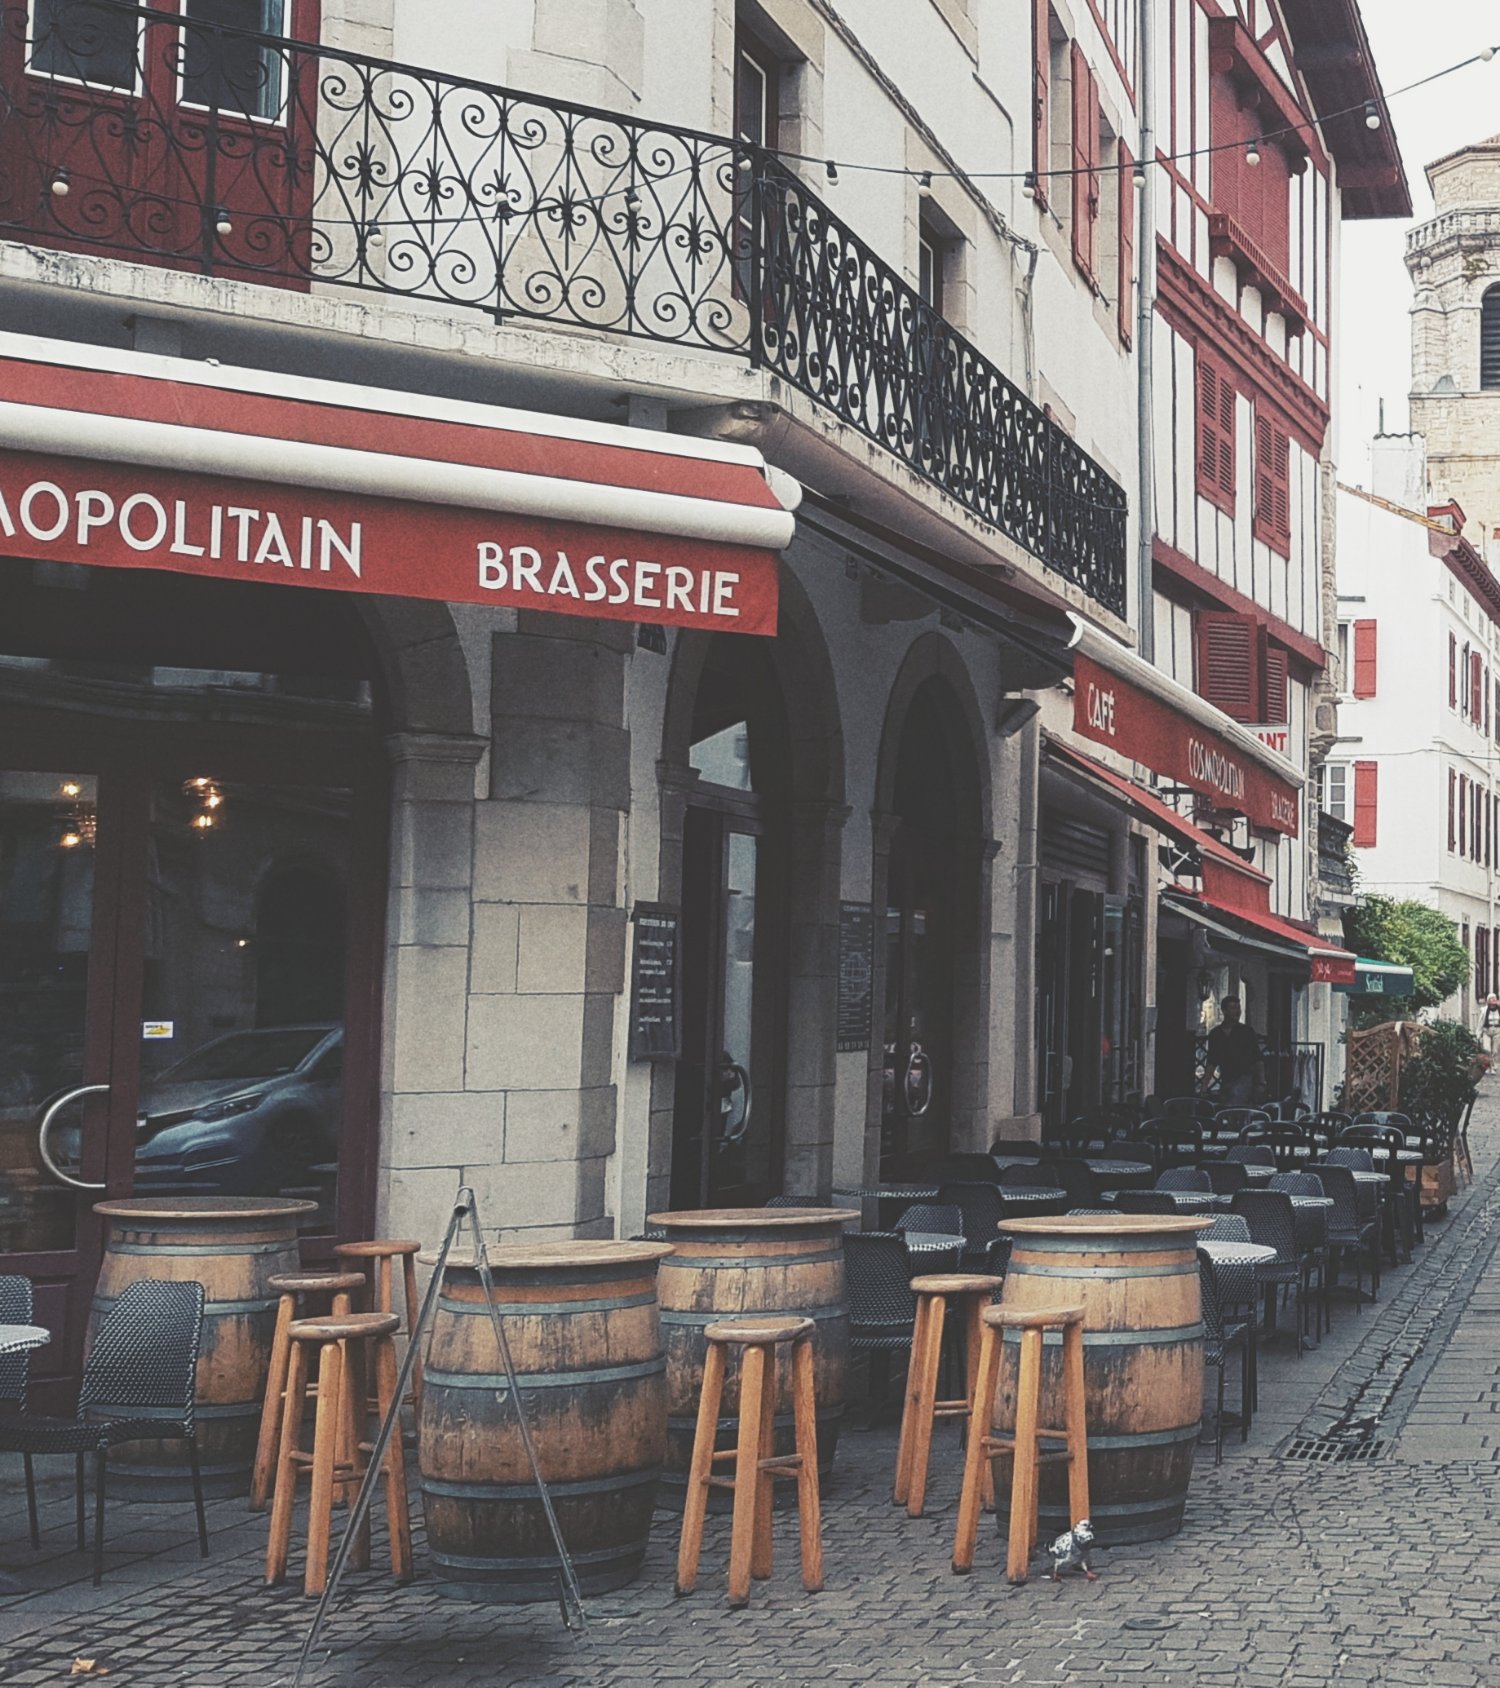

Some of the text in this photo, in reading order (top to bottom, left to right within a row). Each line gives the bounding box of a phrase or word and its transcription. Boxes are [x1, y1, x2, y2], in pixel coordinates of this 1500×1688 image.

[0, 481, 740, 616] OPOLITAIN BRASSERIE
[1087, 682, 1116, 737] CAFÉ
